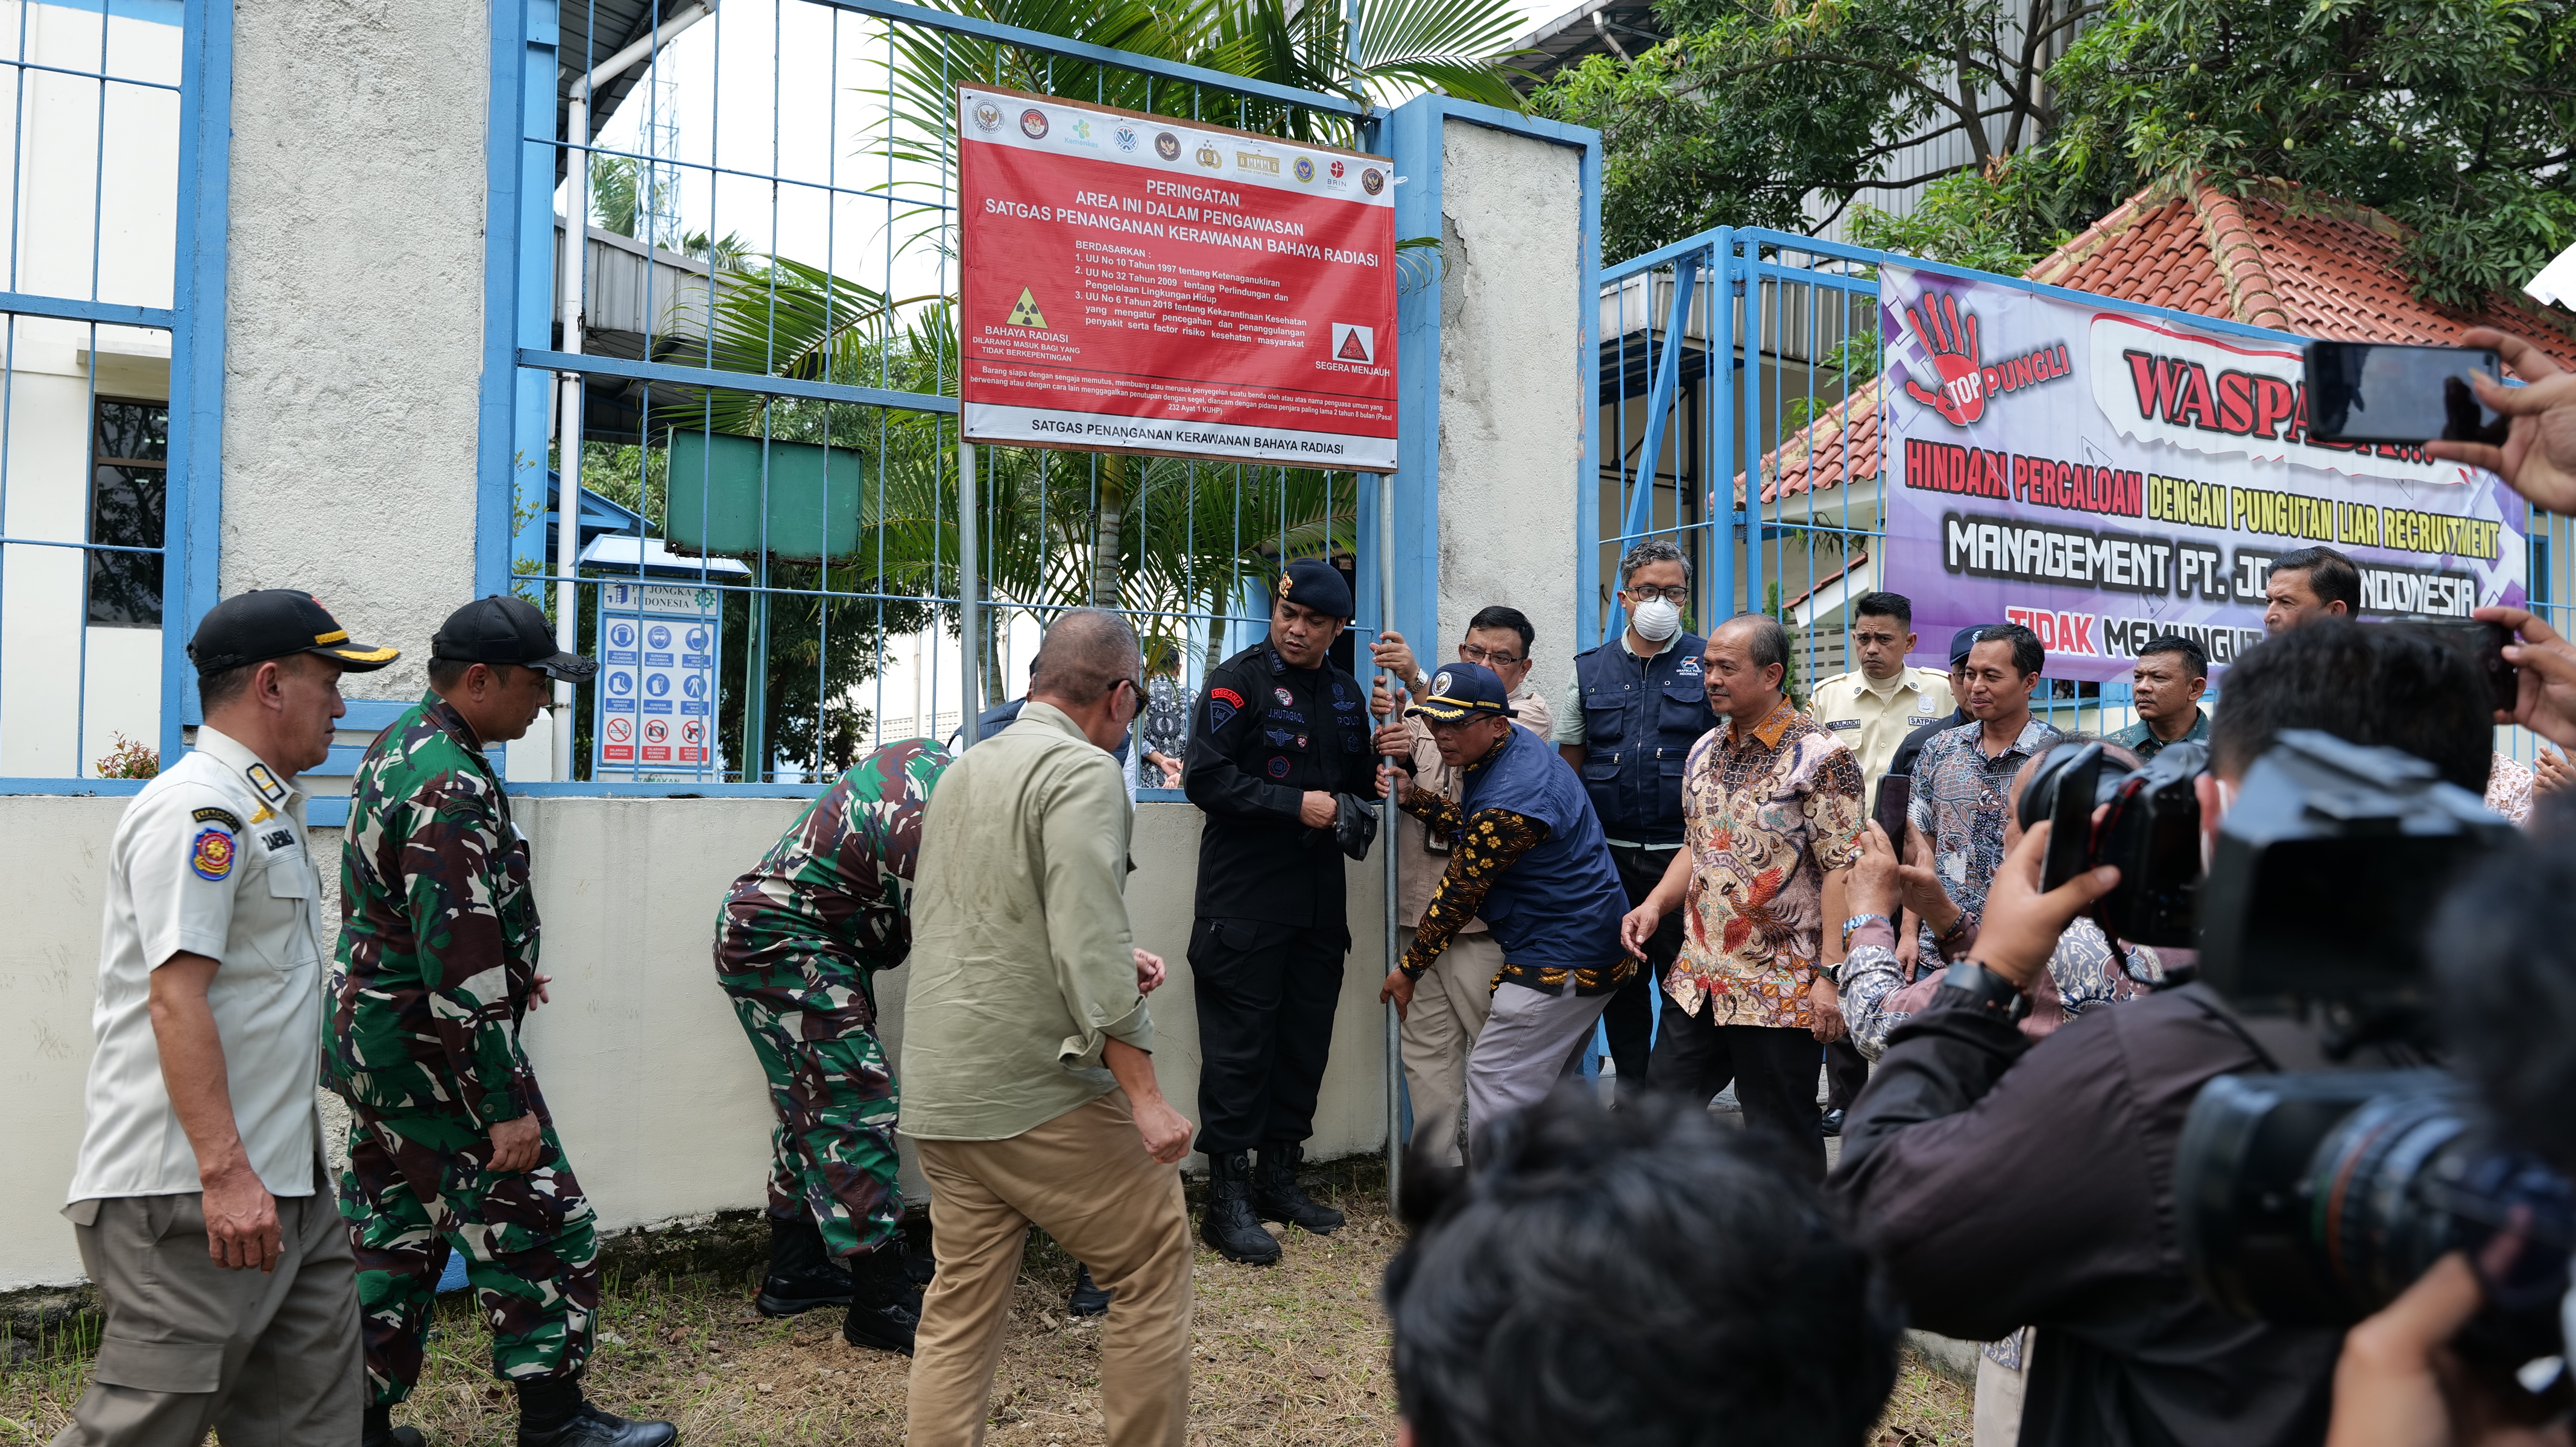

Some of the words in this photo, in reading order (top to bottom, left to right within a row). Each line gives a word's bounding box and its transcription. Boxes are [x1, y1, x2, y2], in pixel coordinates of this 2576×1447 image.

[1064, 136, 1099, 148] Kemenkes
[1147, 180, 1239, 206] PERINGATAN
[1327, 178, 1346, 188] BRIN
[1076, 191, 1119, 210] AREA
[1123, 197, 1141, 213] INI
[1146, 201, 1199, 221] DALAM
[1203, 210, 1303, 236] PENGAWASAN
[985, 198, 1051, 221] SATGAS
[1056, 209, 1163, 236] PENANGANAN
[1169, 225, 1262, 251] KERAWANAN
[1267, 239, 1321, 259] BAHAYA
[1324, 248, 1378, 266] RADIASI
[1076, 241, 1145, 256] BERDASARKAN
[1085, 254, 1099, 262] UU
[1102, 256, 1114, 264] No
[1128, 259, 1155, 270] Tahun
[1157, 263, 1176, 273] 1997
[1178, 266, 1210, 279] tentang
[1212, 271, 1280, 286] Ketenaganukliran
[1075, 265, 1083, 274] 2.
[1085, 268, 1099, 277] UU
[1102, 270, 1114, 278] No
[1116, 271, 1126, 280] 32
[1128, 273, 1155, 283] Tahun
[1158, 277, 1177, 286] 2009
[1184, 280, 1214, 292] tentang
[1219, 285, 1270, 299] Perlindungan
[1274, 293, 1288, 301] dan
[1085, 280, 1139, 293] Pengelolaan
[1141, 286, 1191, 300] Lingkungan
[1193, 292, 1217, 304] Hidup
[1075, 291, 1082, 299] 3.
[1085, 292, 1099, 301] UU
[1102, 294, 1114, 302] No
[1124, 296, 1151, 306] Tahun
[1153, 300, 1172, 309] 2018
[1175, 303, 1205, 315] tentang
[1207, 306, 1263, 320] Kekarantinaan
[1265, 314, 1307, 325] Kesehatan
[1085, 306, 1106, 315] yang
[1114, 309, 1156, 320] mengatur
[1163, 315, 1212, 325] pencegahan
[1218, 320, 1233, 328] dan
[1239, 324, 1305, 337] penanggulangan
[1085, 318, 1123, 327] penyakit
[1154, 323, 1178, 333] factor
[1182, 327, 1205, 336] risiko
[1211, 330, 1251, 341] kesehatan
[1258, 333, 1304, 347] masyarakat
[973, 336, 1011, 346] DILARANG
[1013, 341, 1039, 349] MASUK
[985, 326, 1026, 338] BAHAYA
[1029, 330, 1068, 342] RADIASI
[1006, 349, 1072, 361] BERKEPENTINGAN
[982, 366, 1007, 376] Barang
[1009, 369, 1027, 377] siapa
[1029, 370, 1053, 380] dengan
[1055, 374, 1079, 383] sengaja
[1115, 380, 1149, 389] membuang
[1315, 361, 1350, 371] SEGERA
[1351, 365, 1389, 376] MENJAUH
[1944, 372, 1981, 411] STOP
[1981, 345, 2071, 397] PUNGLI
[970, 375, 1008, 386] berwenang
[1026, 380, 1050, 389] dengan
[1081, 387, 1128, 396] menggagalkan
[1129, 391, 1161, 400] penutupan
[1163, 394, 1185, 402] dengan
[1187, 396, 1206, 404] segel,
[1301, 406, 1318, 415] paling
[1360, 410, 1375, 418] bulan
[1376, 411, 1392, 421] (Pasal
[1202, 406, 1222, 415] KUHP)
[1032, 420, 1082, 433] SATGAS
[1087, 424, 1172, 441] PENANGANAN
[1176, 431, 1250, 446] KERAWANAN
[1254, 437, 1298, 450] BAHAYA
[1301, 441, 1343, 454] RADIASI
[1904, 437, 2010, 500] HINDARI
[2013, 453, 2142, 517] PERCALOAN
[2148, 473, 2227, 529] DENGAN
[2231, 487, 2333, 541] PUNGUTAN
[2338, 501, 2379, 547] LIAR
[2383, 507, 2499, 560] RECRUITMENT
[1948, 520, 2170, 589] MANAGEMENT
[2179, 548, 2226, 595] PT.
[2359, 569, 2475, 617] NDONESIA
[634, 597, 689, 608] IDONESIA
[649, 586, 692, 596] JONGKA
[1214, 690, 1240, 705] GEGANA
[1267, 708, 1305, 724] J.HUTAGAOL
